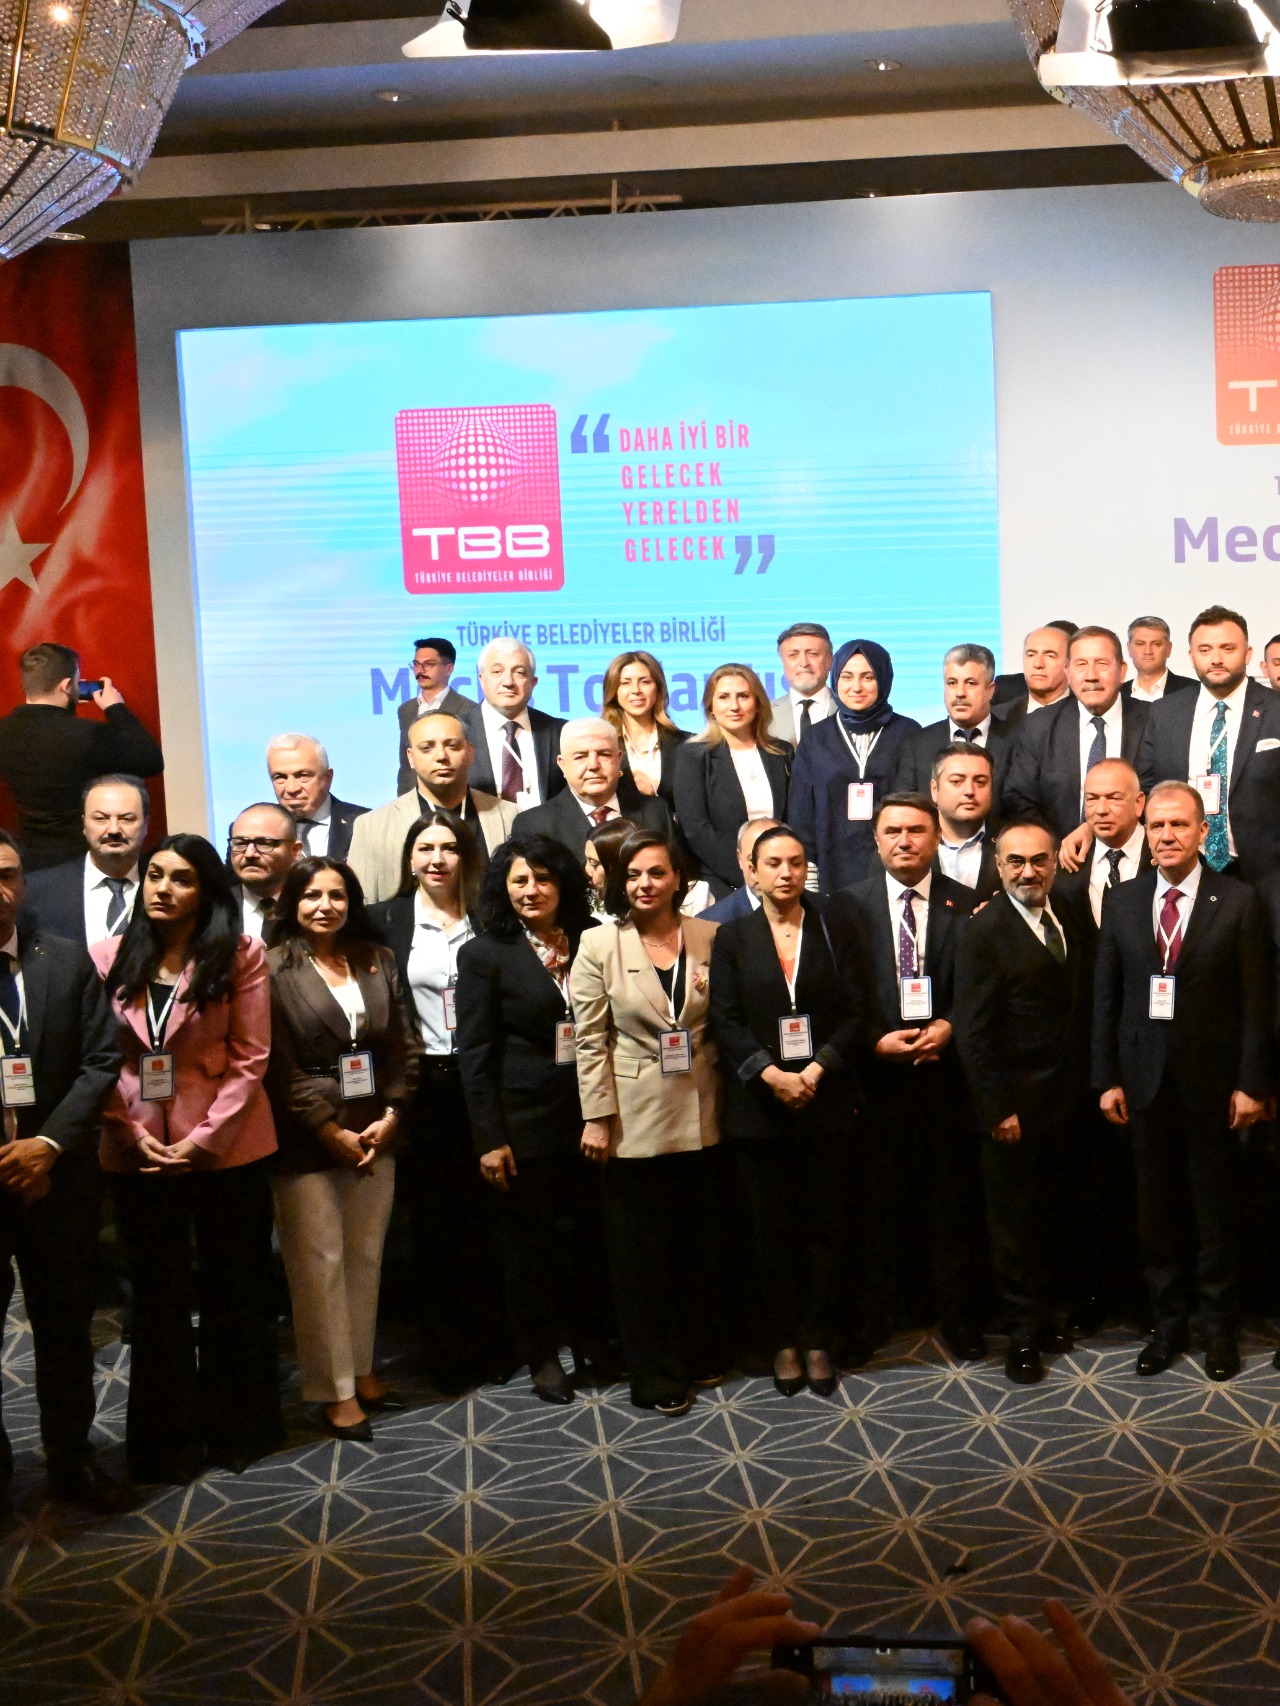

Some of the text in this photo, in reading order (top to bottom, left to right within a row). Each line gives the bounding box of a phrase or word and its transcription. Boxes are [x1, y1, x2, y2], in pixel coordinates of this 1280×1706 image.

[619, 419, 750, 452] DAHA İYİ BİR
[1229, 422, 1271, 435] TÜRKİYE
[621, 462, 722, 490] GELECEK
[622, 498, 740, 526] YERELDEN
[412, 524, 551, 561] TBB
[624, 535, 726, 563] GELECEK
[415, 566, 553, 585] TÜRKİYE BELEDİYELER BİRLİĞİ
[537, 618, 656, 646] BELEDİYELER
[660, 615, 726, 644] BİRLİĞİ
